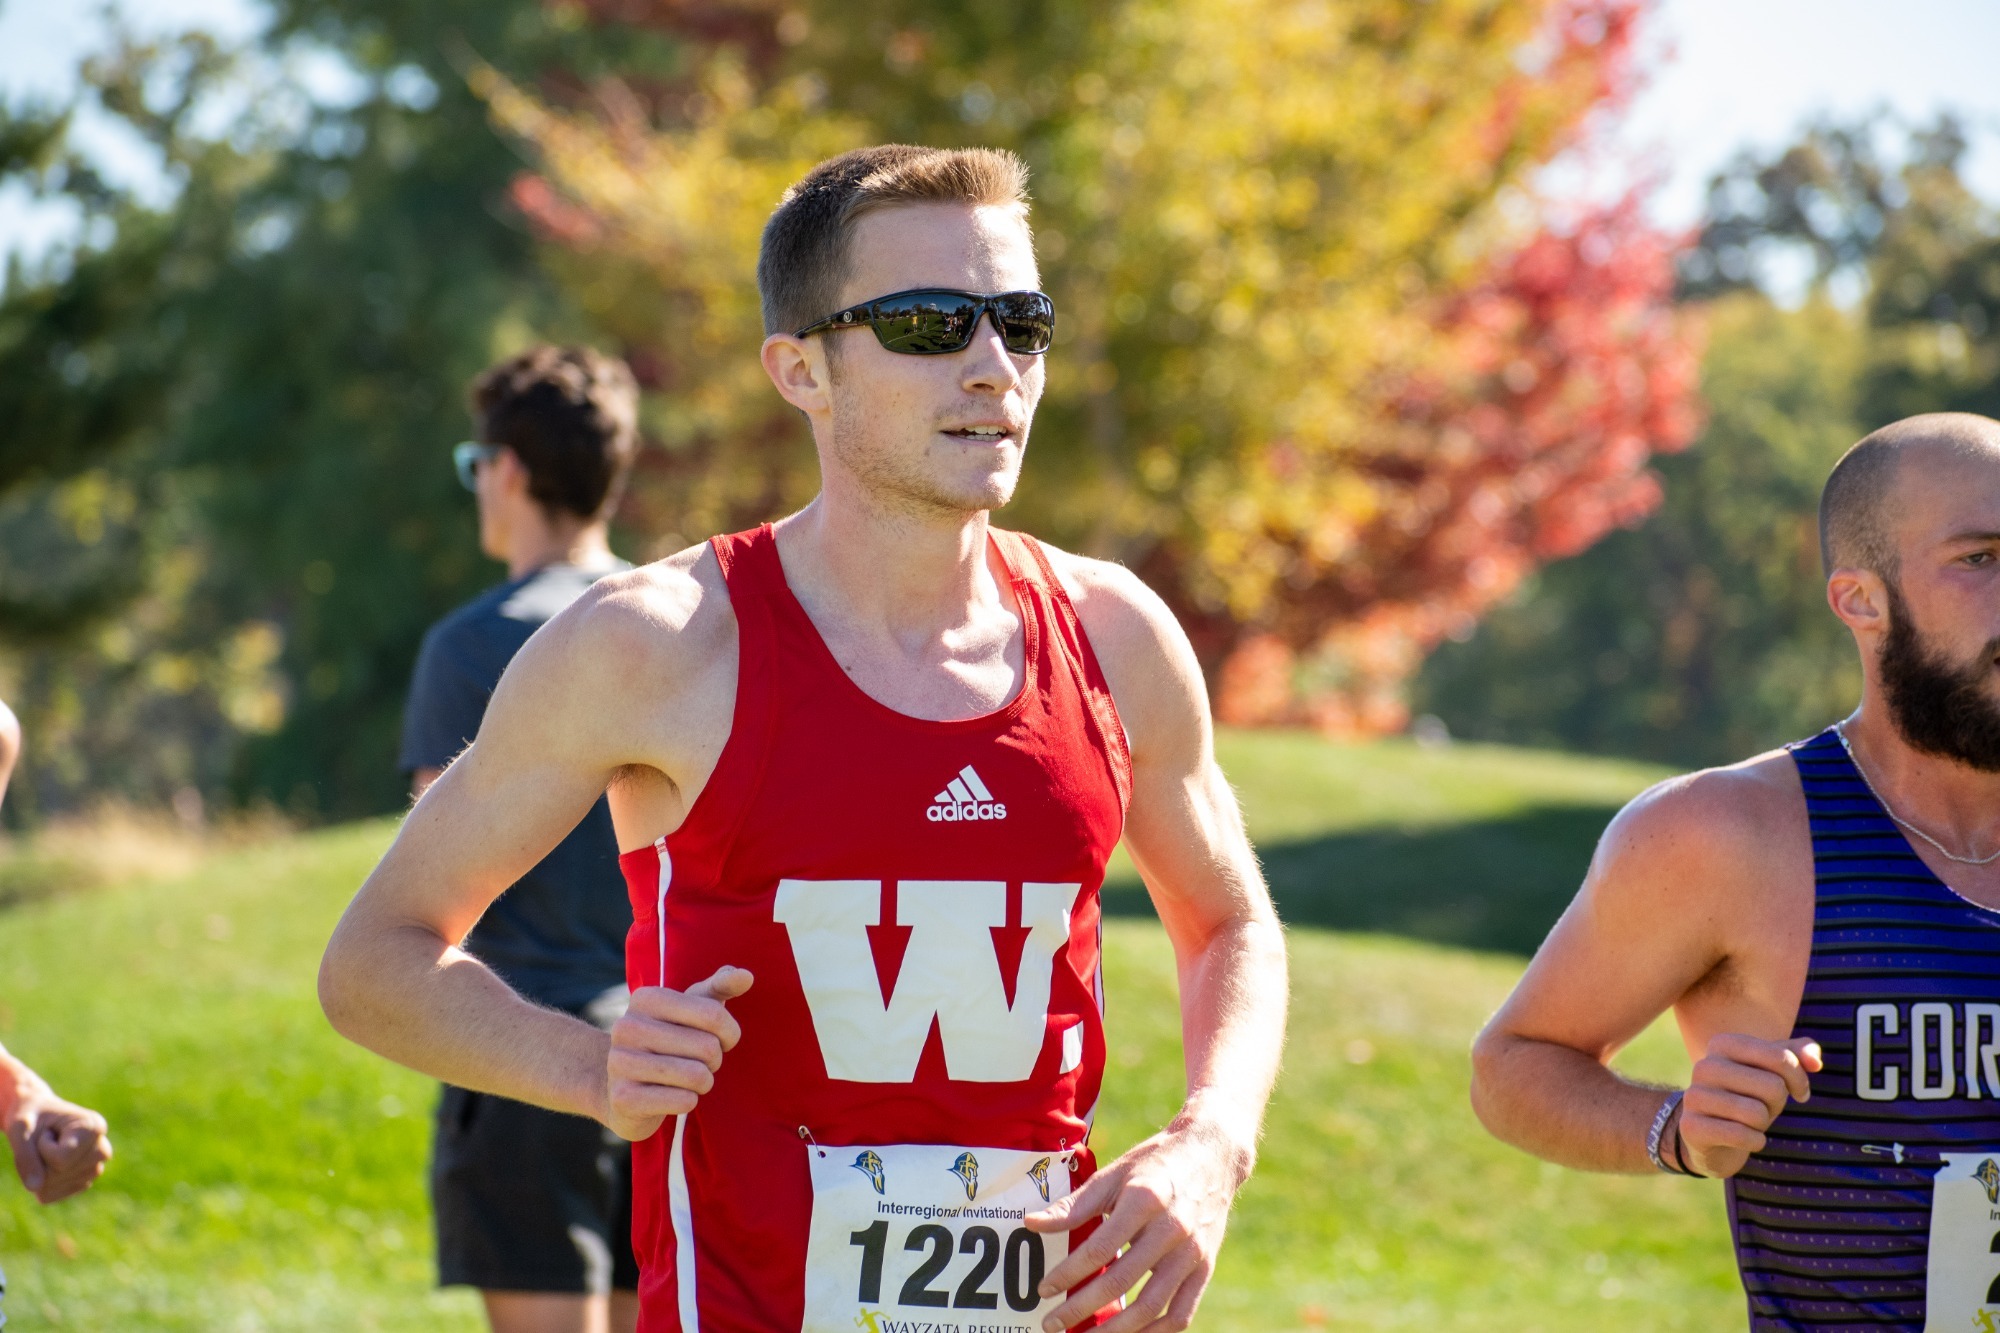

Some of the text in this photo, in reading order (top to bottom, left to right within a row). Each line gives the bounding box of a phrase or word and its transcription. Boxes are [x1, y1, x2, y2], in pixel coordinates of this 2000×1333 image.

[926, 800, 1007, 822] adidas
[773, 878, 1082, 1083] W
[1856, 1003, 2000, 1100] COR
[877, 1201, 1026, 1220] Interregional Invitational
[850, 1220, 1045, 1312] 1220
